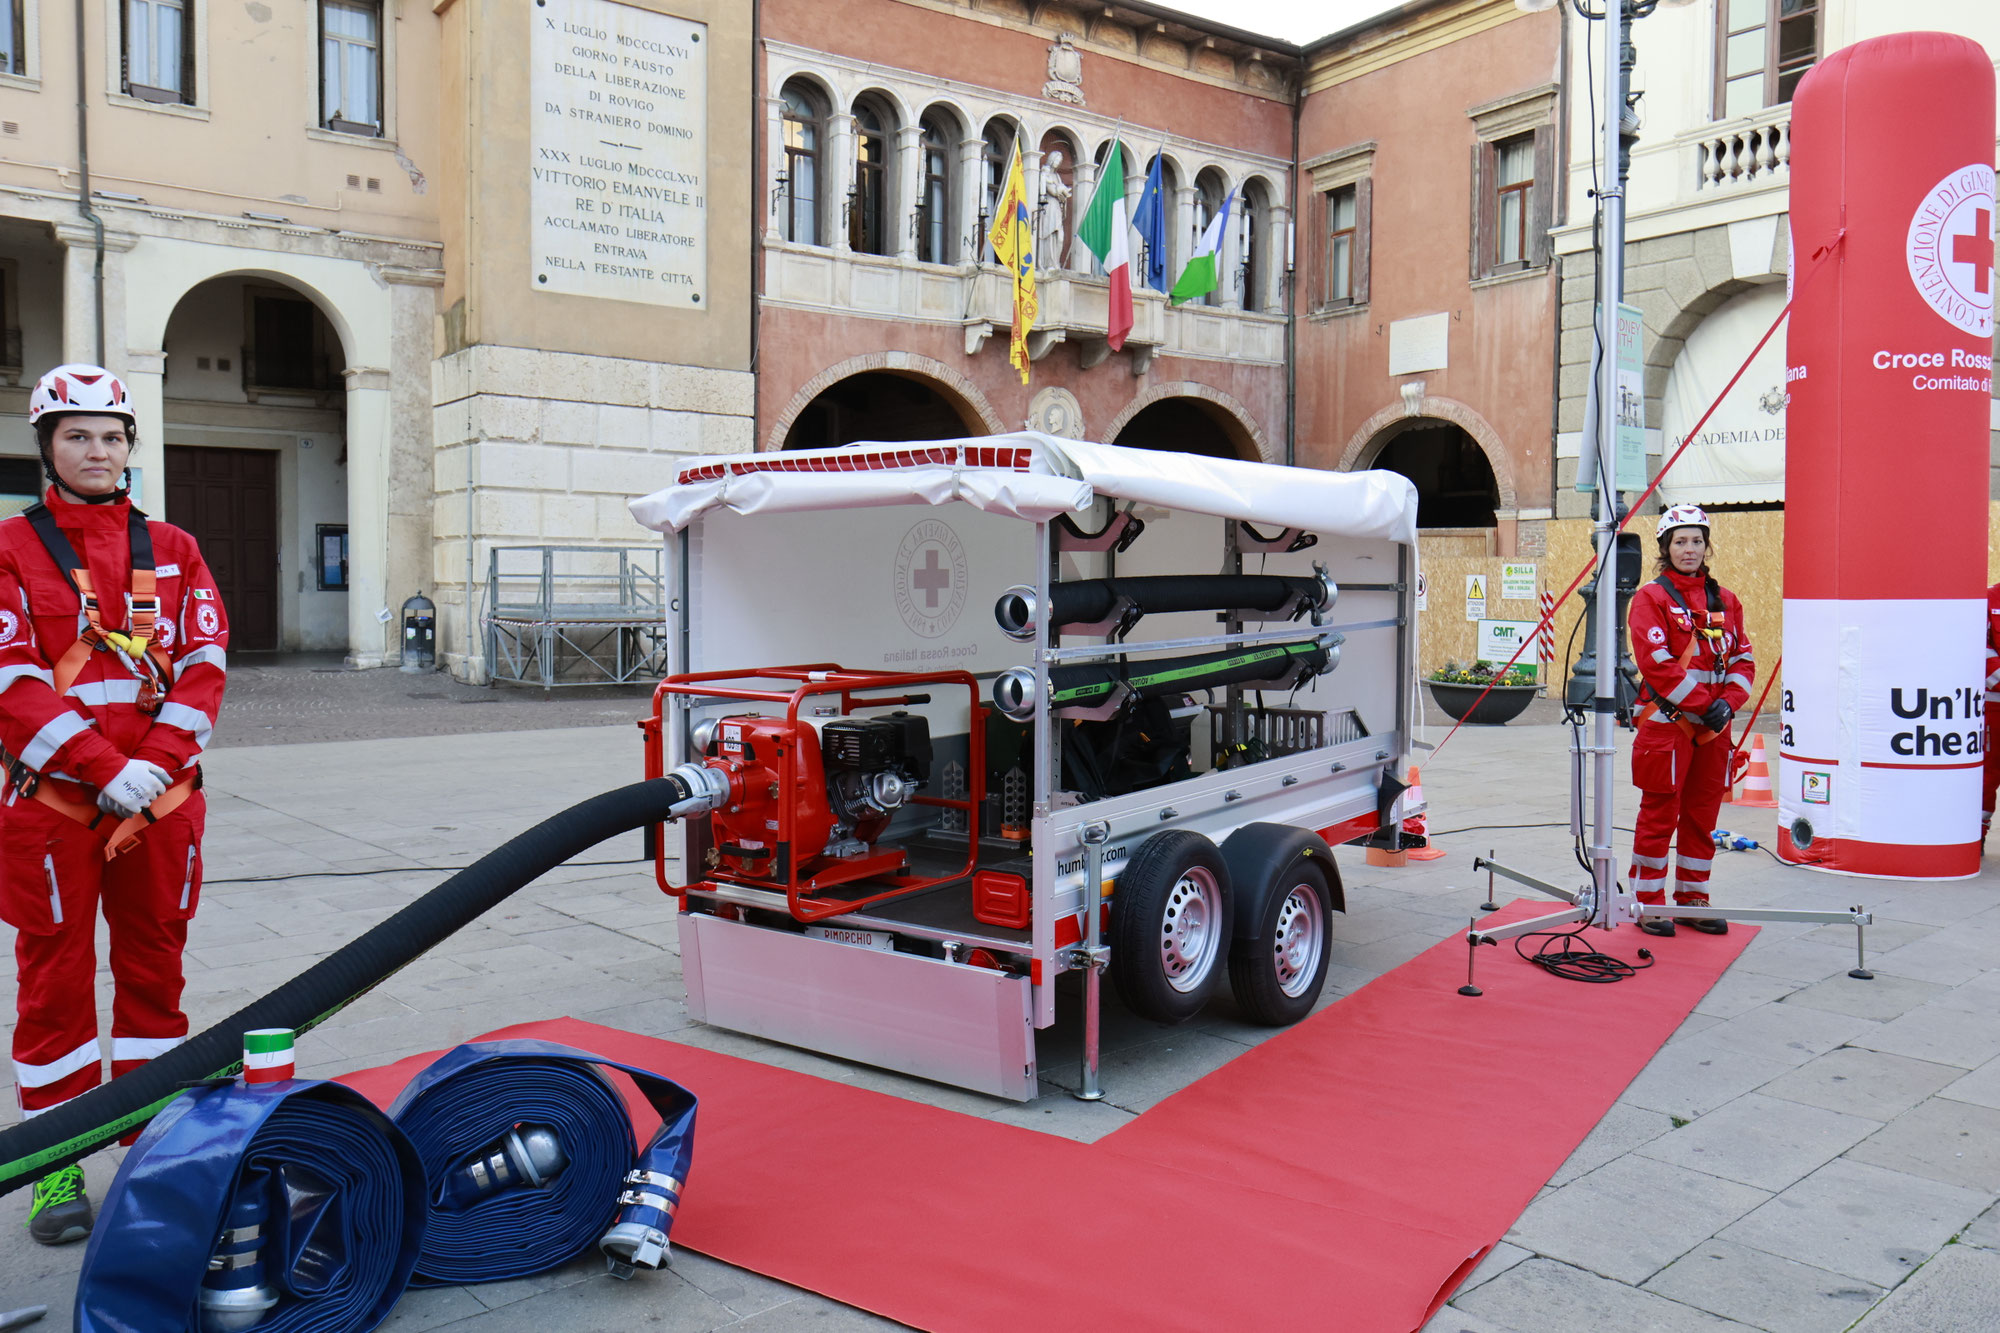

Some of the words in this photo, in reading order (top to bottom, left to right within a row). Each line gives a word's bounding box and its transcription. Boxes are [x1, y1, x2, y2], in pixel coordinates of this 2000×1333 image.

[545, 18, 556, 30] X
[563, 22, 607, 41] LUGLIO
[617, 34, 688, 60] MDCCCLXVI
[572, 46, 617, 64] GIORNO
[624, 57, 674, 77] FAUSTO
[554, 62, 597, 81] DELLA
[605, 72, 686, 100] LIBERAZIONE
[589, 90, 601, 102] DI
[609, 94, 654, 112] ROVIGO
[545, 102, 561, 116] DA
[569, 108, 641, 130] STRANIERO
[648, 122, 693, 140] DOMINIO
[540, 147, 570, 163] XXX
[580, 155, 622, 172] LUGLIO
[628, 162, 699, 186] MDCCCLXVI
[533, 167, 607, 191] VITTORIO
[696, 196, 703, 208] II
[1937, 183, 1960, 208] DI
[575, 198, 594, 213] RE
[544, 216, 619, 236] ACCLAMATO
[626, 228, 695, 247] LIBERATORE
[594, 243, 647, 260] ENTRAVA
[1913, 203, 1975, 327] CONVENZIONE
[545, 255, 586, 271] NELLA
[595, 263, 655, 281] FESTANTE
[1873, 350, 1945, 370] Croce
[1913, 375, 1980, 391] Comitato
[1671, 430, 1760, 448] ACCADEMIA
[1493, 626, 1515, 638] CMT
[1890, 687, 1985, 720] Un'It
[1890, 725, 1962, 756] che
[123, 781, 145, 800] HyFlex
[824, 929, 872, 945] RIMORCHIO
[70, 1131, 105, 1151] gomma
[105, 1118, 133, 1135] torino
